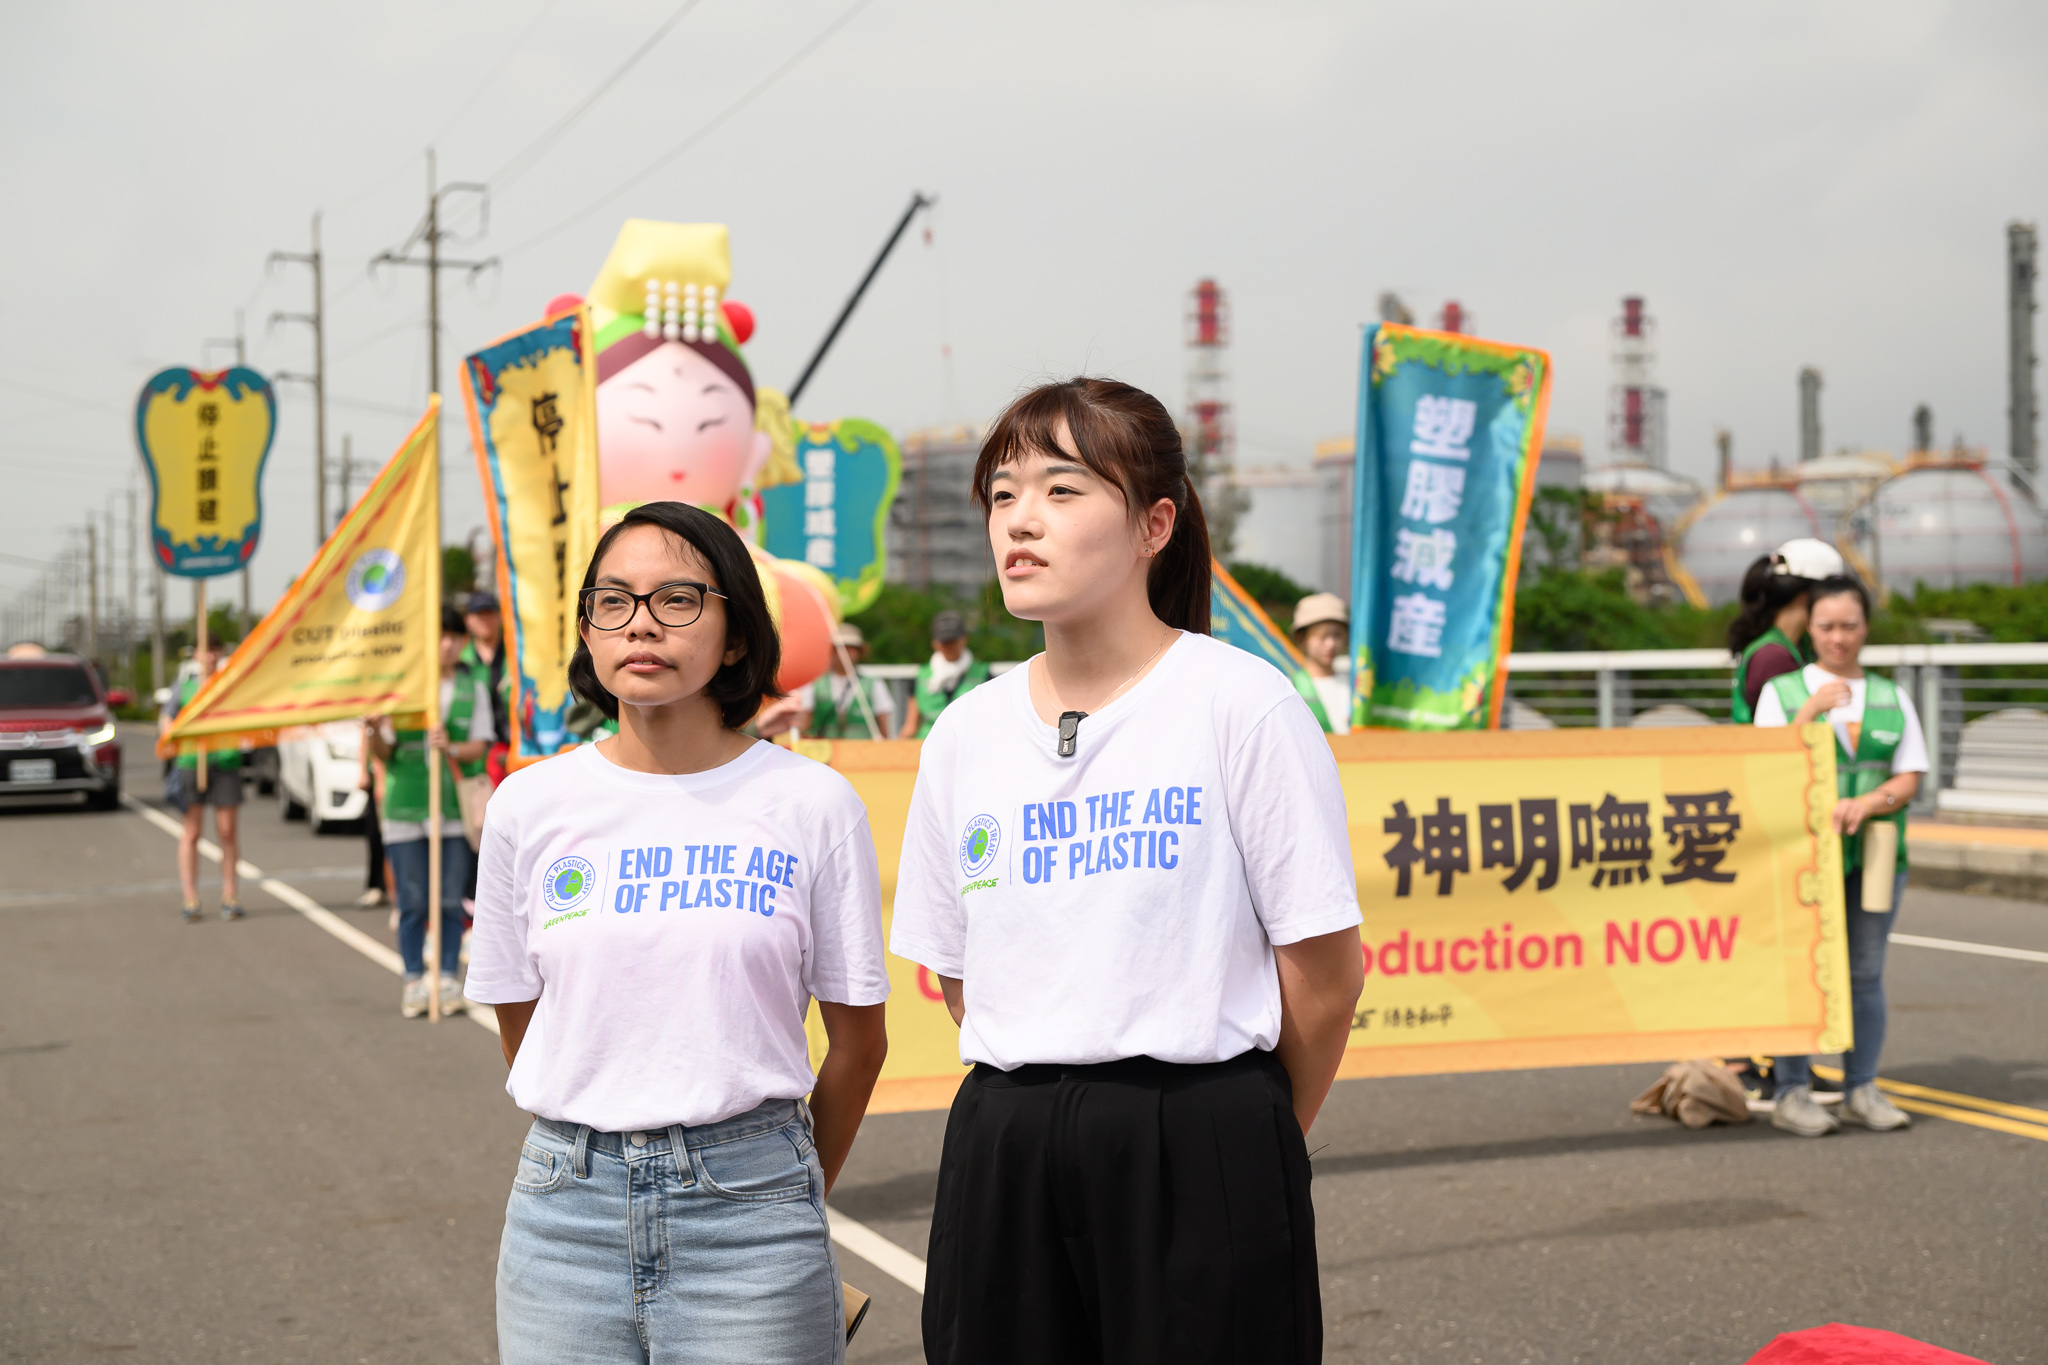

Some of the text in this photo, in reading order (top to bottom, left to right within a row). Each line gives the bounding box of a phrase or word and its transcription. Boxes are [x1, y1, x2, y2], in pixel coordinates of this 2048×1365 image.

[1023, 786, 1203, 842] END THE AGE
[967, 818, 993, 833] PLASTICS
[986, 828, 998, 858] TREATY
[1022, 830, 1179, 885] OF PLASTIC
[1382, 789, 1742, 898] 神明嘸愛
[545, 859, 593, 902] GLOBAL PLASTICS TREATY
[618, 844, 799, 889] END THE AGE
[543, 908, 591, 930] GREENPEACE
[614, 878, 777, 918] OF PLASTIC
[1605, 915, 1741, 966] NOW
